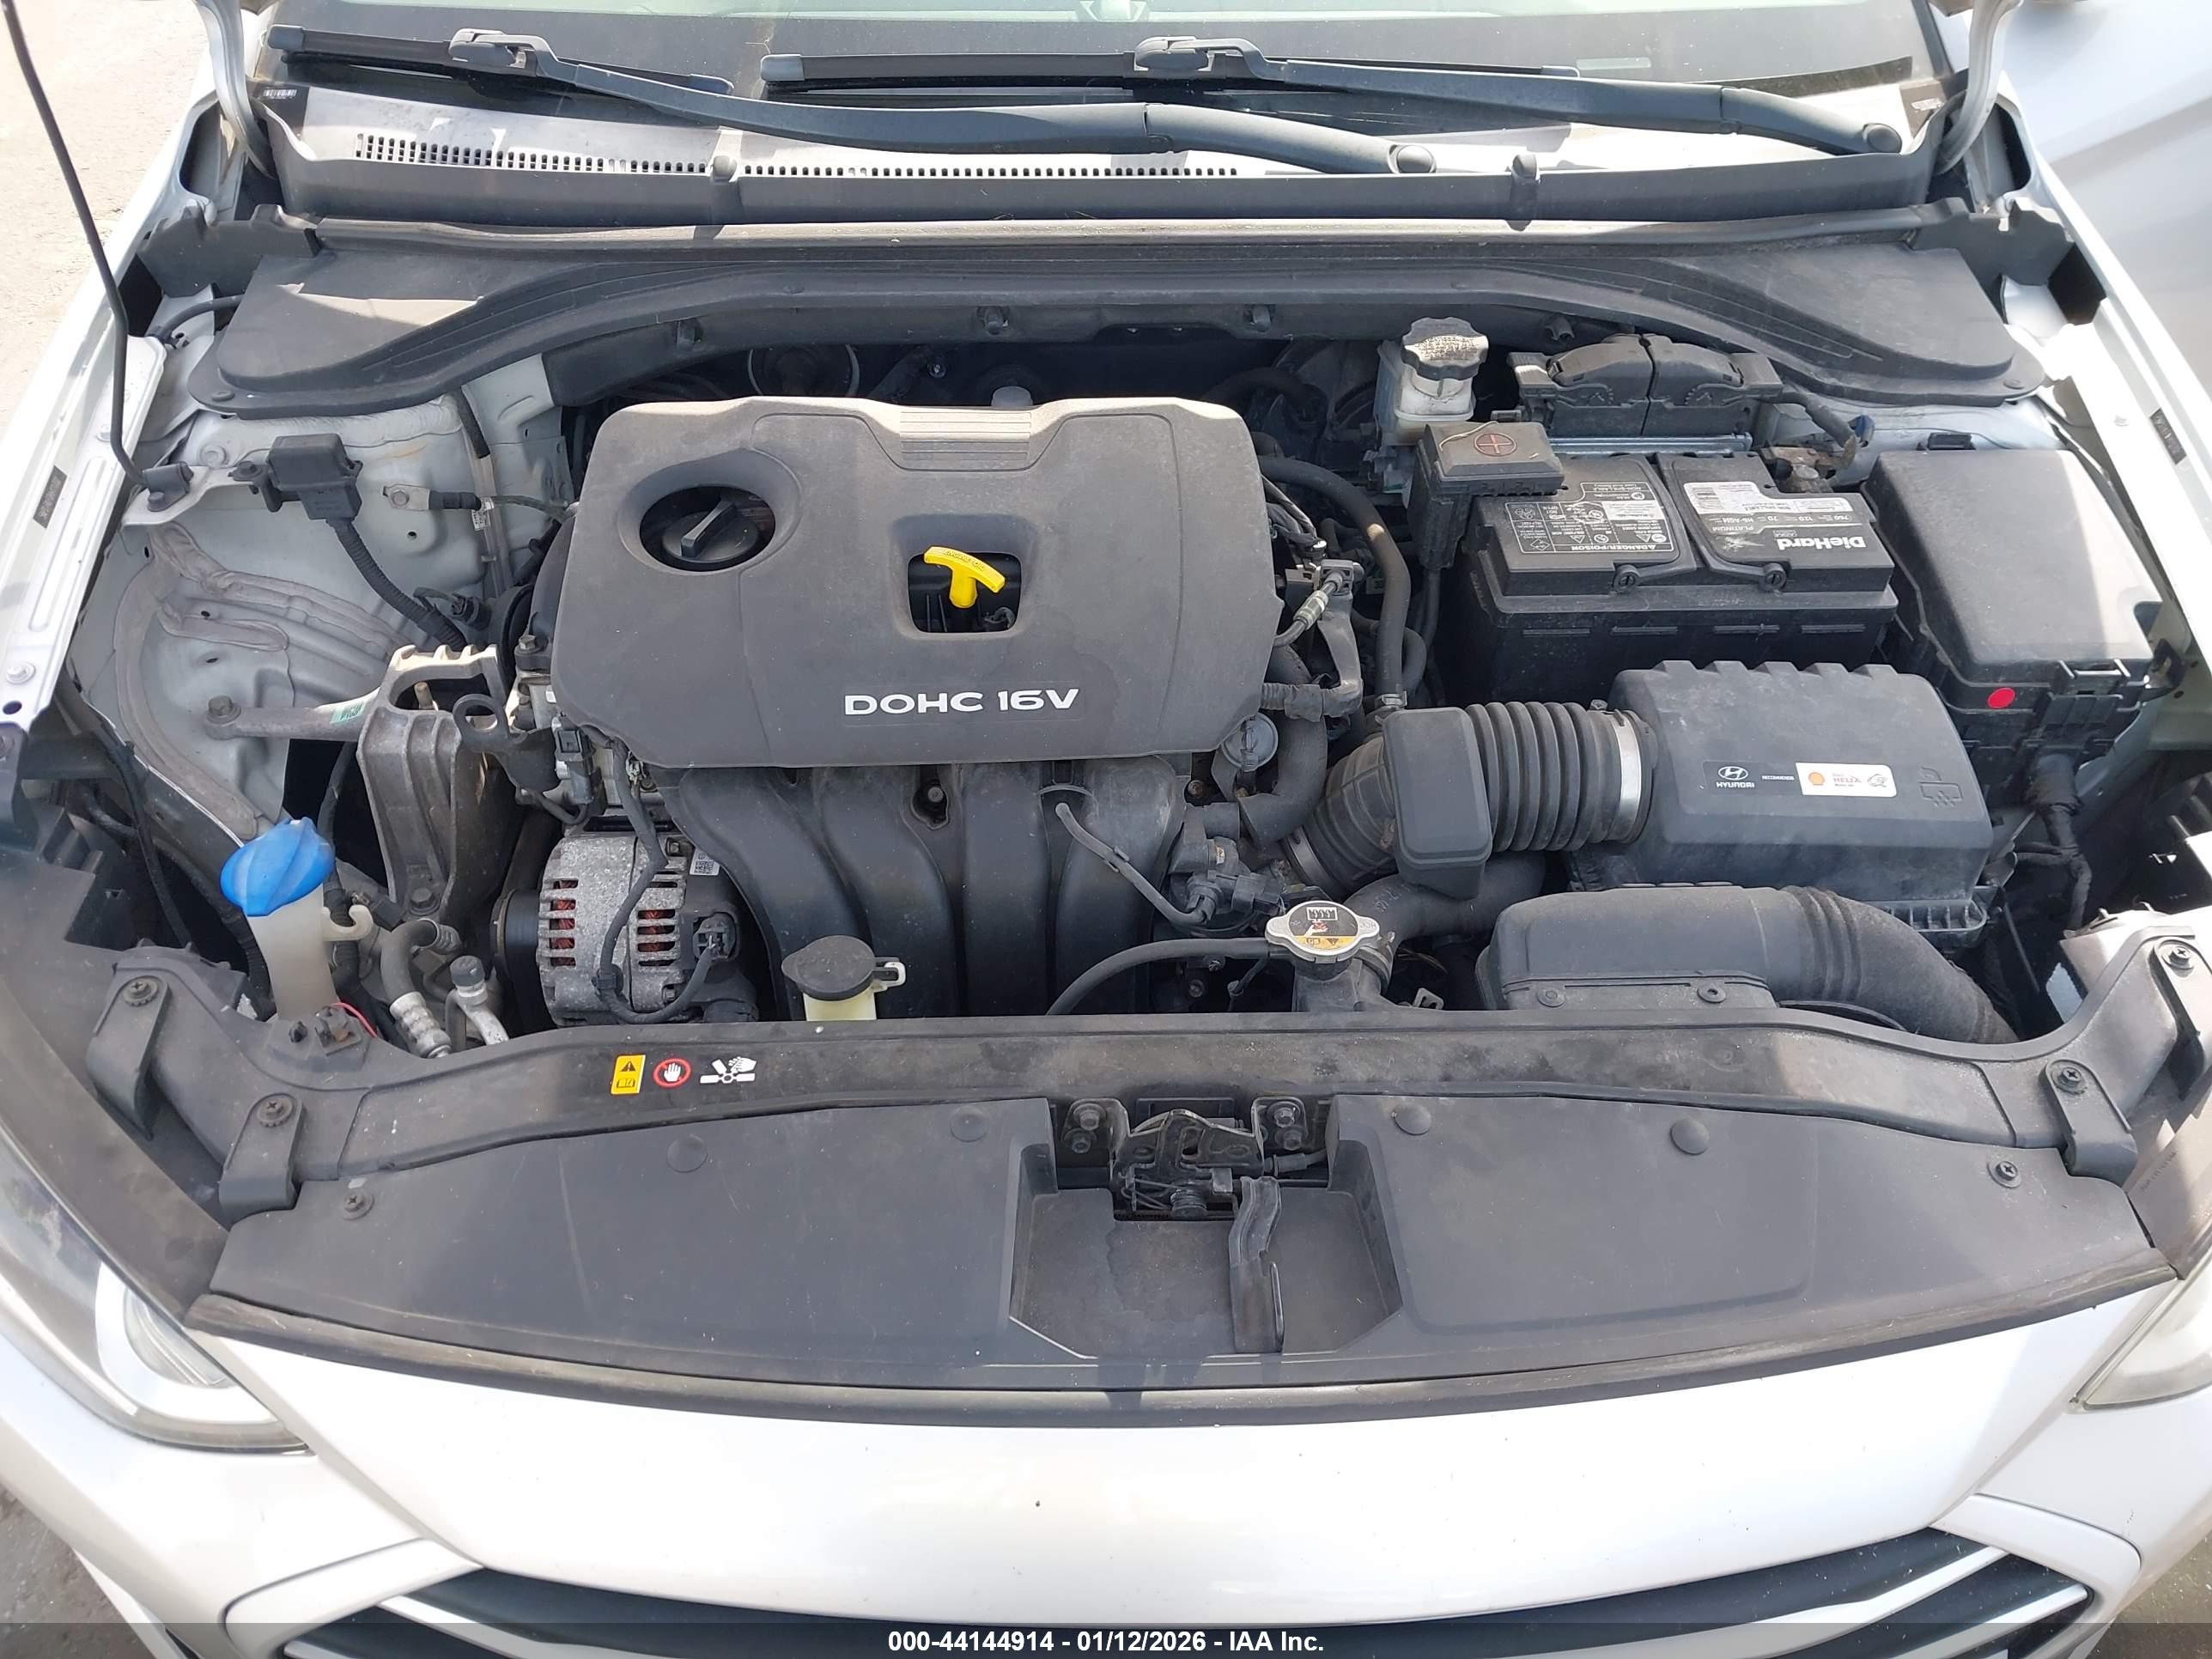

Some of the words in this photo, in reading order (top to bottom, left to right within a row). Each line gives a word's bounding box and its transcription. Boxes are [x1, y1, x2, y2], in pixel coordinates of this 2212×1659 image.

[1777, 537, 1867, 550] DieHard
[845, 691, 983, 714] DOHC
[998, 689, 1079, 711] 16V
